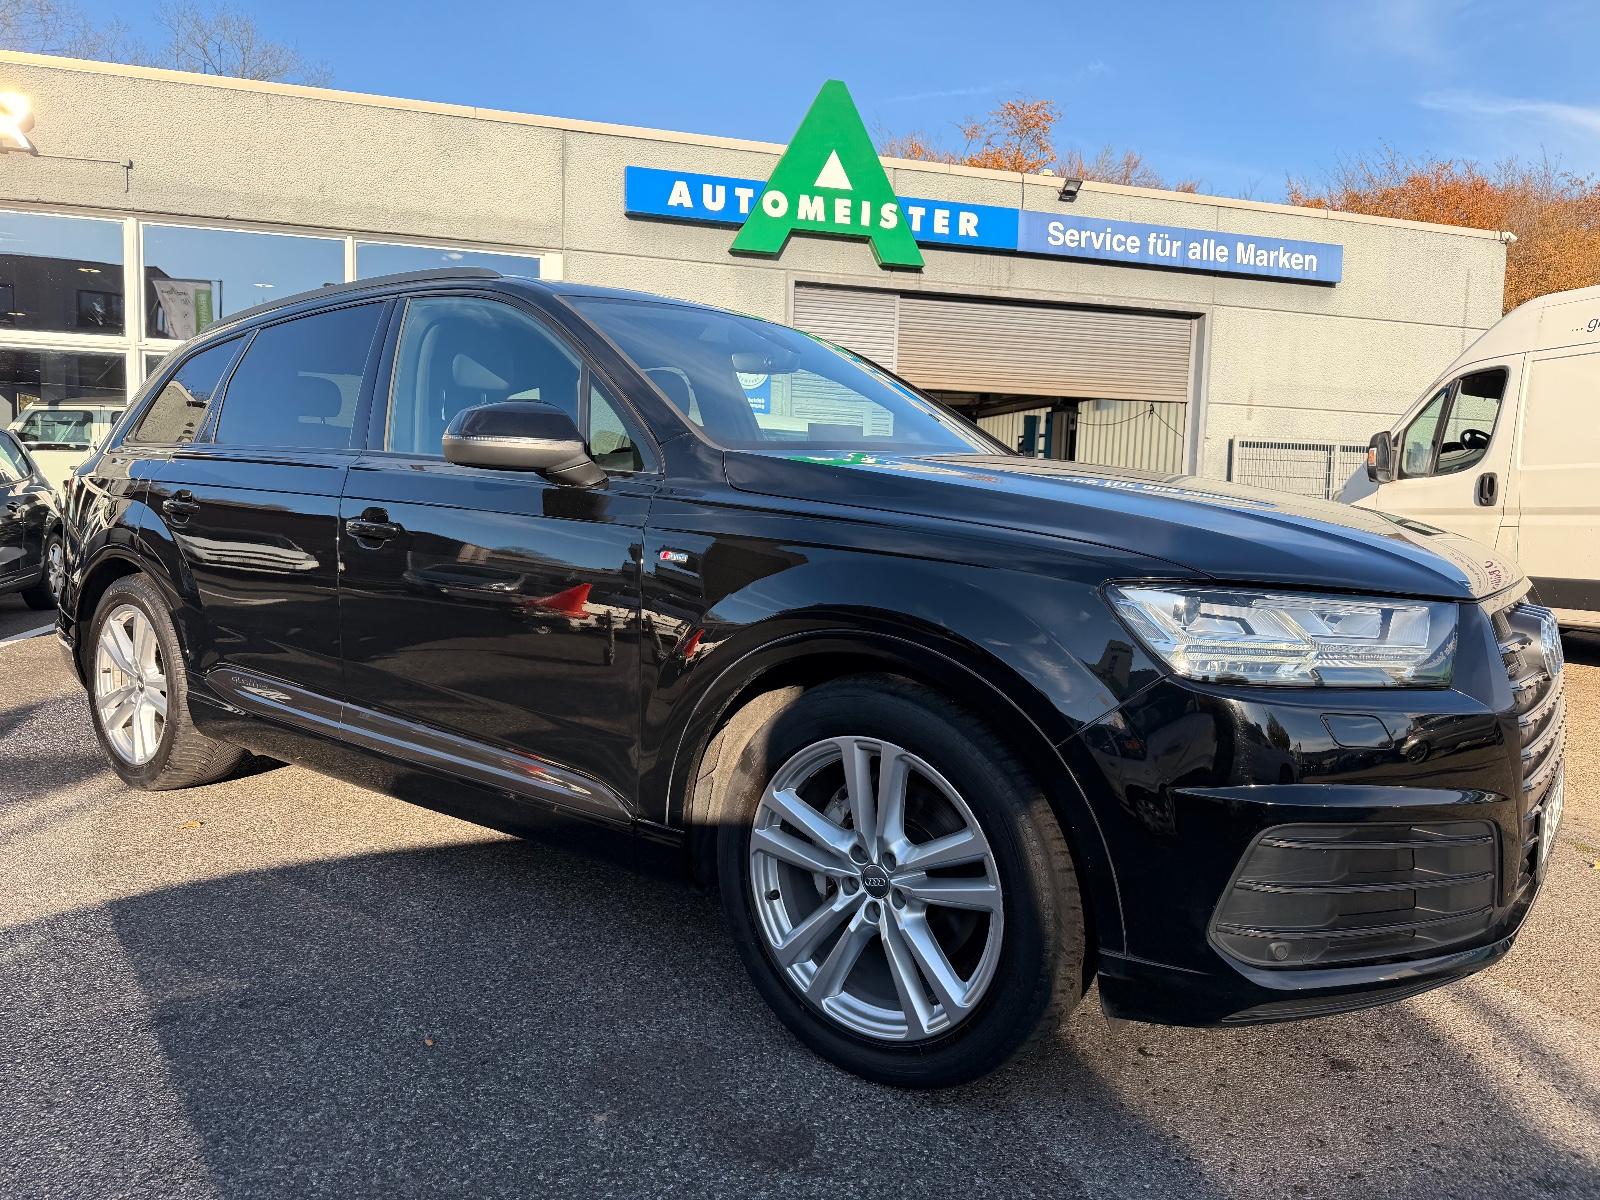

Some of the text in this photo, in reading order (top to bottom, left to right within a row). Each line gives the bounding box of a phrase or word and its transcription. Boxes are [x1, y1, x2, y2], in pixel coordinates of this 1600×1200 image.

[667, 180, 979, 237] AUTOMEISTER
[1047, 221, 1318, 272] Service für alle Marken
